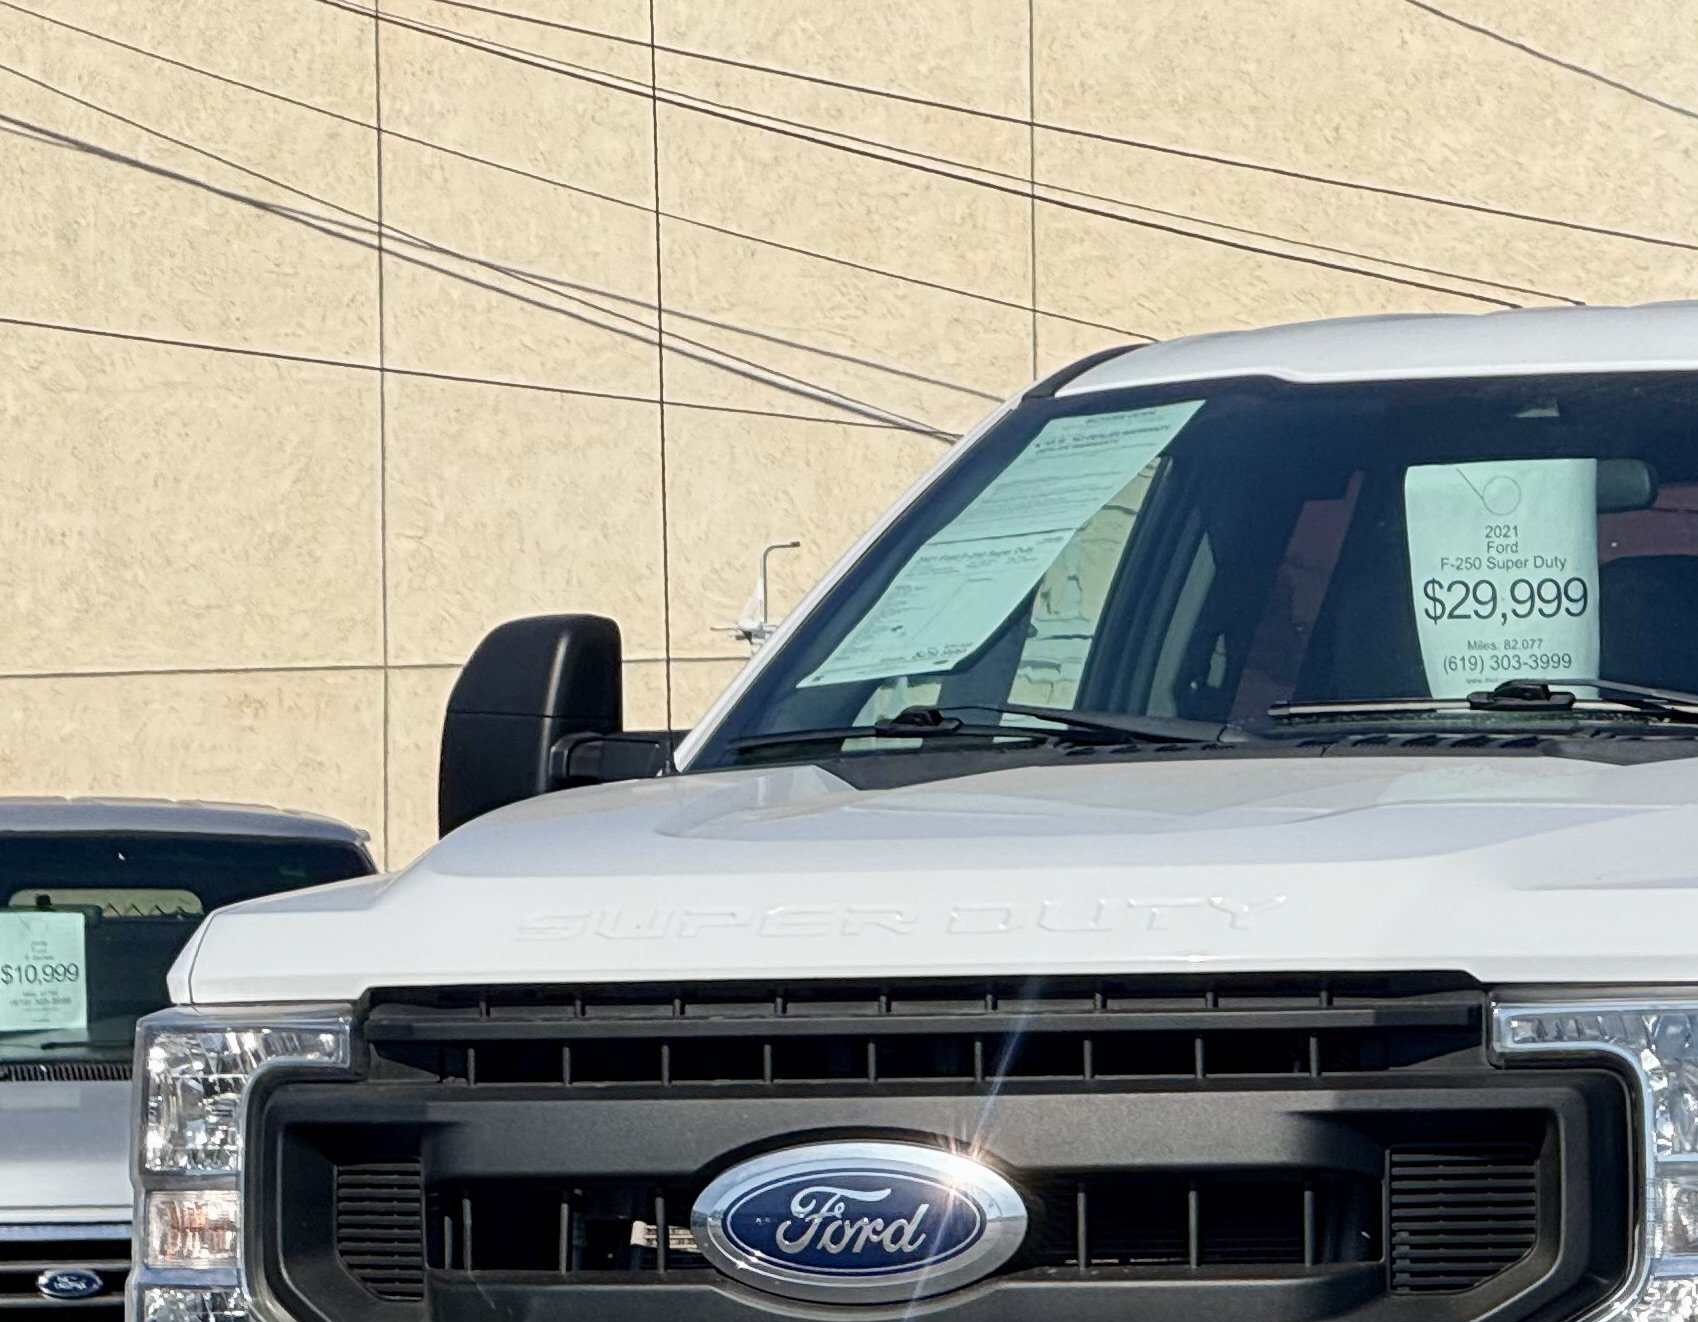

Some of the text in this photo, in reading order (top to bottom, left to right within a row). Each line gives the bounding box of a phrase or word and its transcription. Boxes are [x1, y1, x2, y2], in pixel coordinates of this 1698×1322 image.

[1485, 525, 1518, 539] 2021
[1487, 540, 1519, 554] Ford
[1441, 555, 1567, 572] F-250 Super Duty
[1423, 576, 1588, 626] $29,999
[1443, 652, 1572, 675] (619) 303-3999
[514, 894, 1287, 943] SUPER DUTY
[1, 962, 79, 985] $10,999
[776, 1186, 929, 1254] Ford
